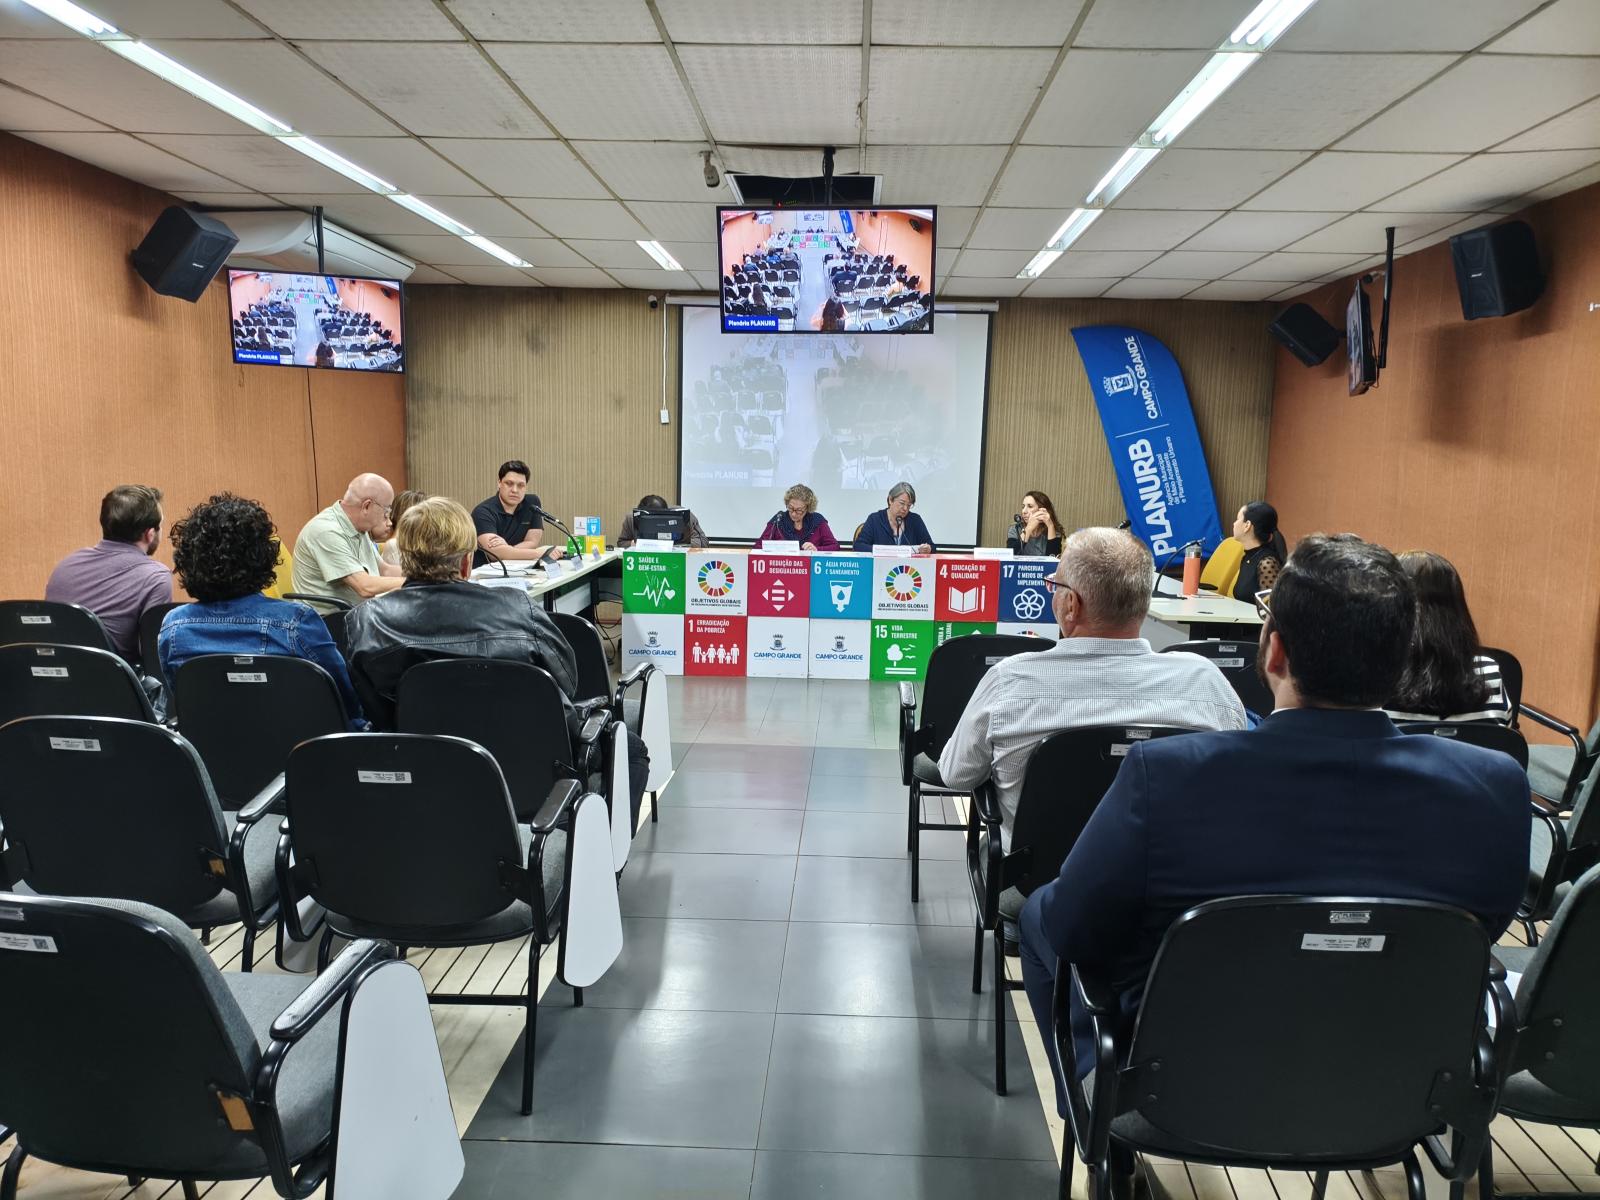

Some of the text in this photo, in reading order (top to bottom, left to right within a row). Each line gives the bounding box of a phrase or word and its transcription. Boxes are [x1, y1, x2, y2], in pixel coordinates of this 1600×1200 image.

[1124, 335, 1147, 379] GRANDE
[1140, 380, 1158, 419] CAMPO
[1165, 436, 1176, 459] Urbano
[1156, 453, 1168, 482] Municipal
[1163, 452, 1175, 480] Ambiente
[1171, 458, 1185, 498] Planejamento
[1128, 438, 1177, 557] PLANURB
[626, 556, 635, 571] 3
[638, 556, 655, 564] SAÚDE
[751, 559, 766, 574] 10
[769, 559, 793, 567] REDUÇÃO
[825, 560, 860, 568] ÁGUA POTÁVEL
[769, 567, 808, 575] DESIGUALDADES
[814, 561, 822, 575] 6
[939, 564, 948, 579] 4
[951, 564, 979, 572] EDUCAÇÃO
[1003, 565, 1015, 578] 17
[688, 619, 694, 632] 1
[696, 619, 730, 627] ERRADICAÇÃO
[874, 625, 888, 638] 15
[891, 632, 918, 640] TERRESTRE
[838, 653, 864, 661] GRANDE
